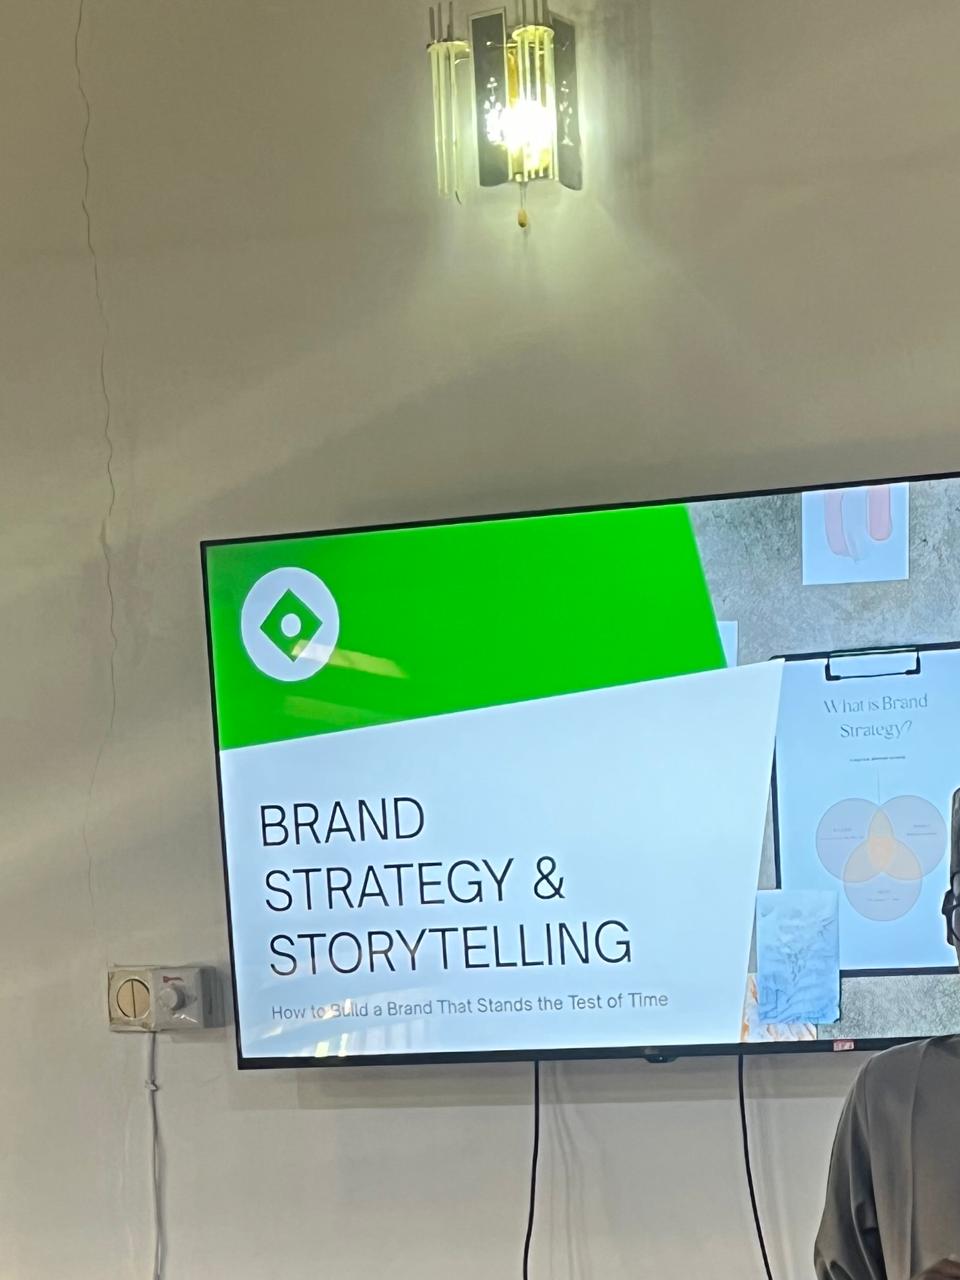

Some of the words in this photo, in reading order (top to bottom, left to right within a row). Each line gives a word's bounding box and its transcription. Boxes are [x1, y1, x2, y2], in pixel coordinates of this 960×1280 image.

[823, 699, 865, 714] What
[868, 700, 880, 712] is
[882, 693, 928, 711] Brand
[840, 719, 913, 740] Strategy?
[260, 796, 425, 847] BRAND
[265, 857, 514, 912] STRATEGY
[533, 856, 566, 899] &
[269, 919, 632, 976] STORYTELLING
[271, 1004, 306, 1020] How
[311, 1004, 326, 1019] to
[330, 1002, 369, 1018] Build
[373, 1005, 383, 1017] a
[387, 1000, 433, 1017] Brand
[437, 999, 473, 1015] That
[477, 997, 533, 1013] Stands
[537, 996, 564, 1012] the
[568, 994, 603, 1010] Test
[607, 993, 623, 1009] of
[628, 992, 669, 1008] Time
